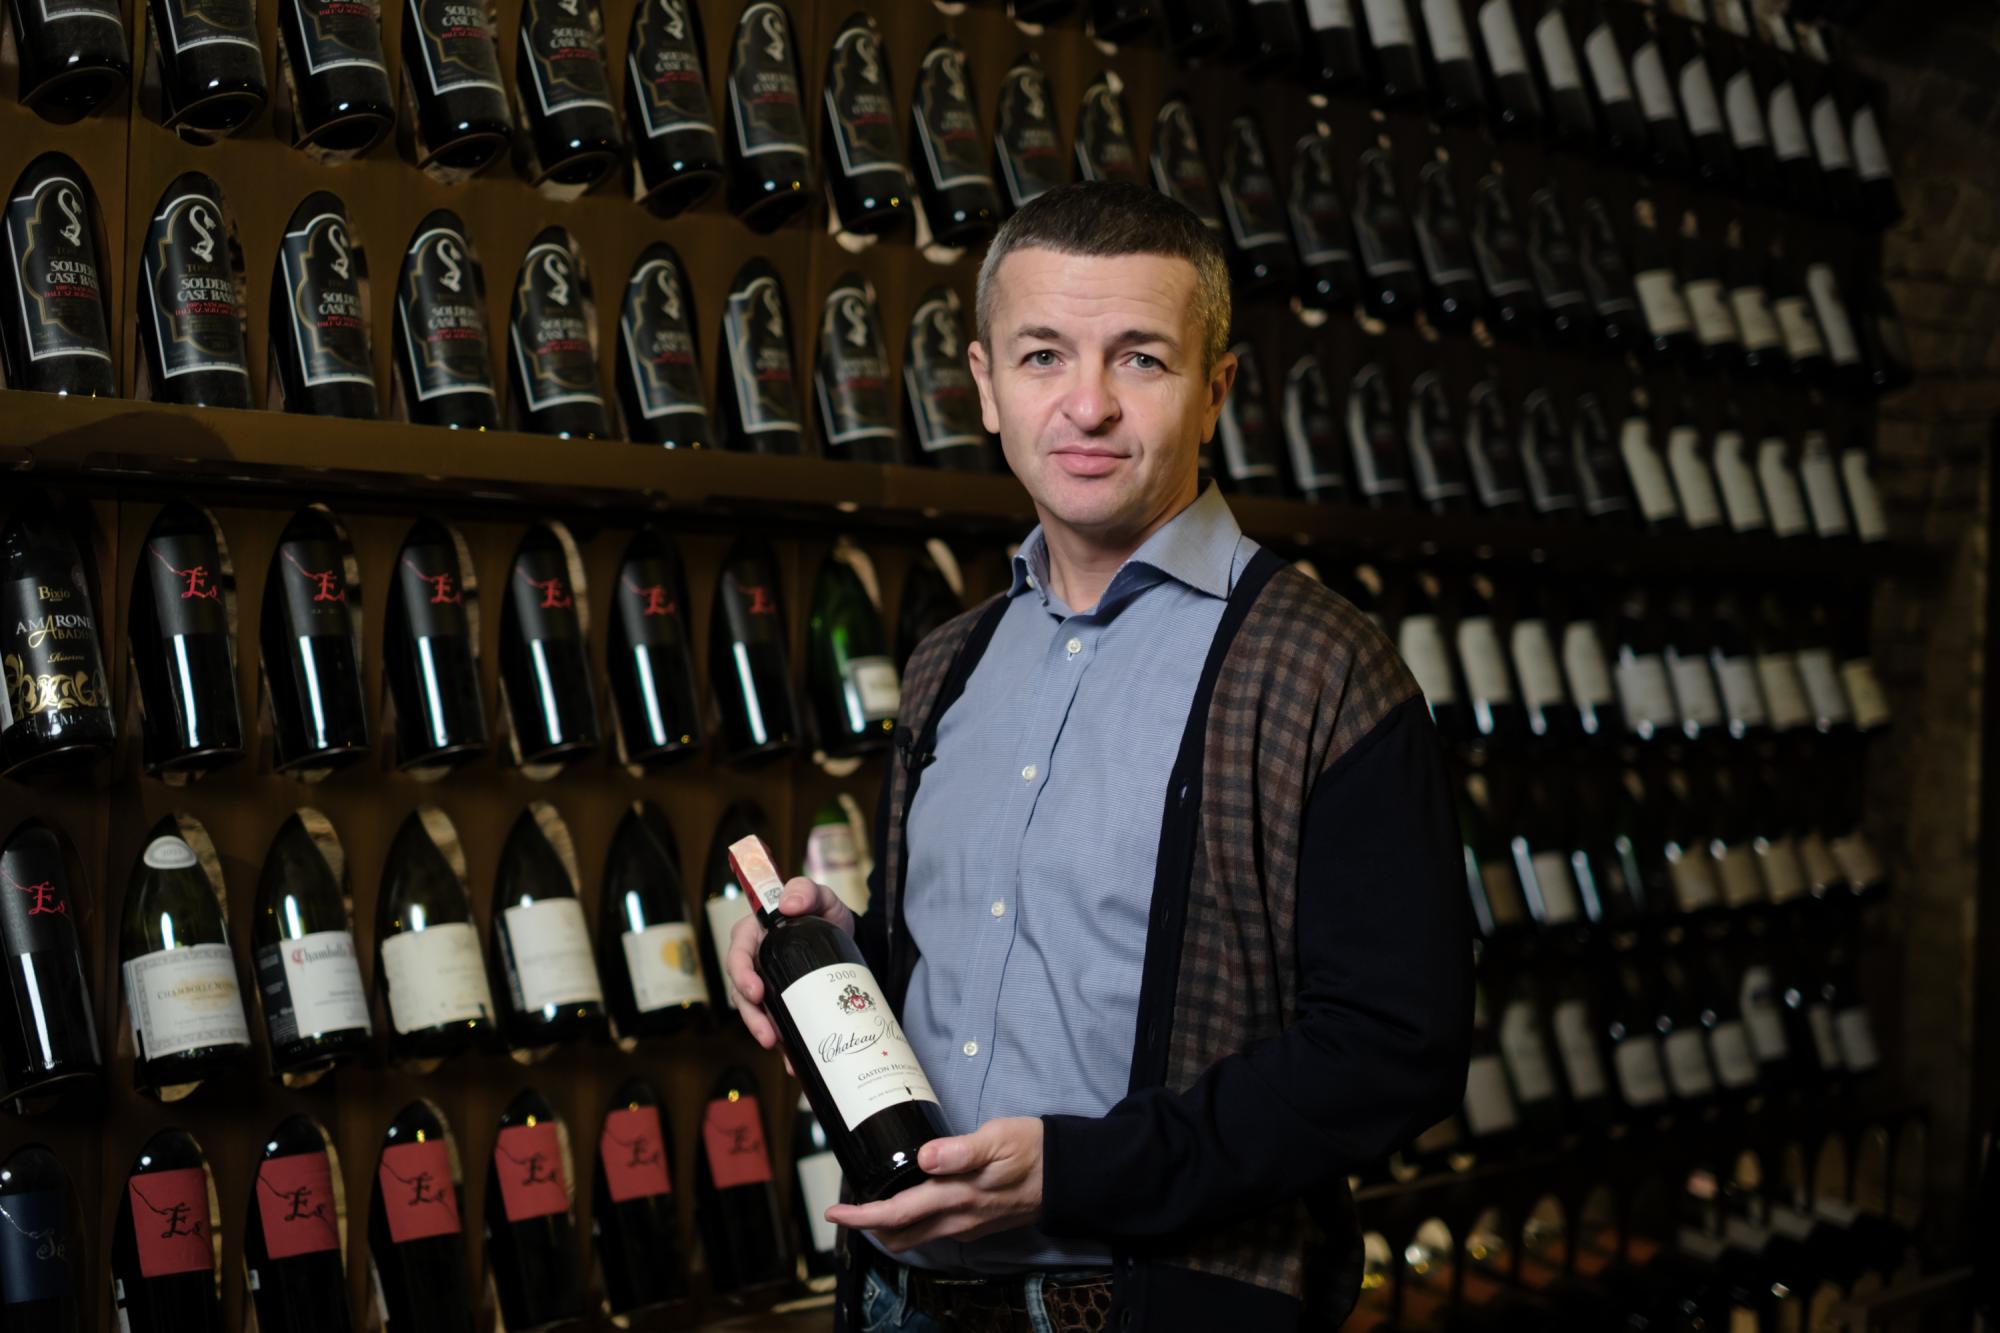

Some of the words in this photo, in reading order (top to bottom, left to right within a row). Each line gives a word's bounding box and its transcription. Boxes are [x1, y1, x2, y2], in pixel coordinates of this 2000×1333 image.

[45, 271, 79, 285] CASE
[176, 289, 209, 302] CASE
[38, 585, 71, 600] Bixio
[827, 969, 857, 983] 2000
[818, 1031, 877, 1064] Chateau
[858, 1063, 890, 1081] GASTON
